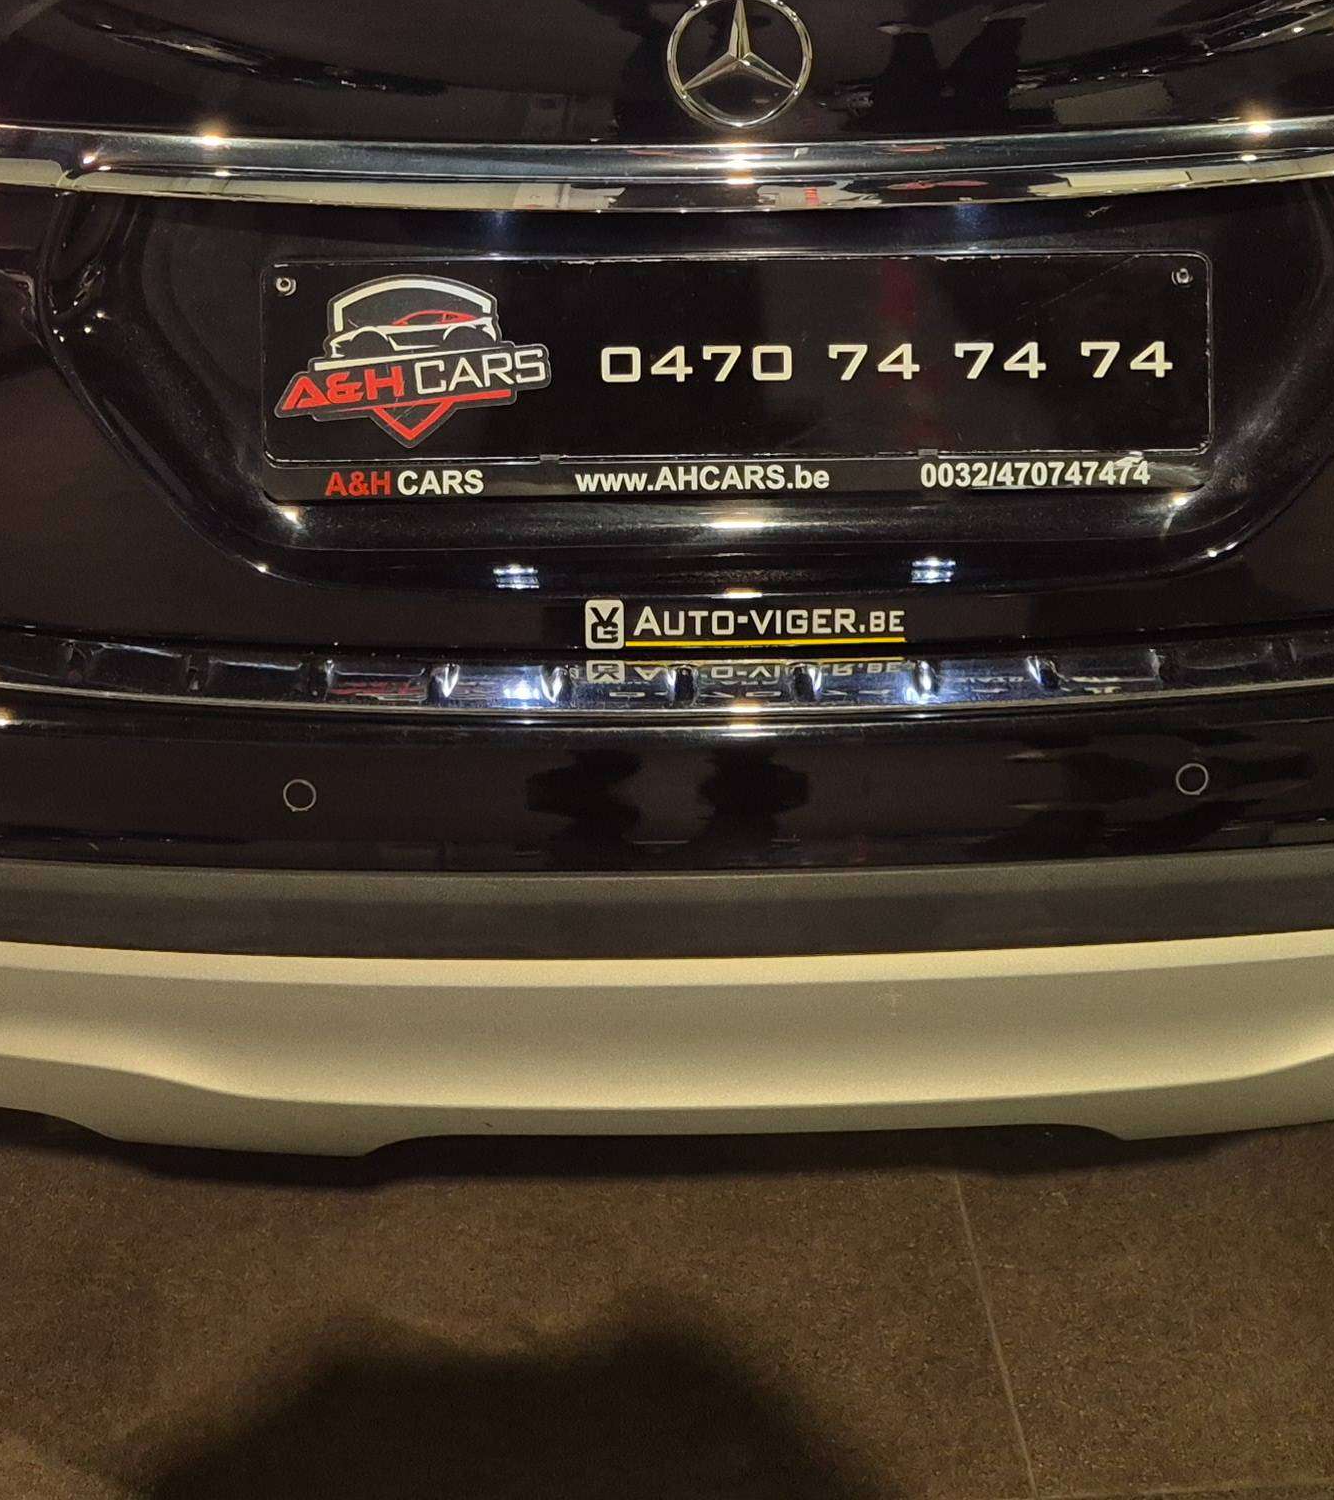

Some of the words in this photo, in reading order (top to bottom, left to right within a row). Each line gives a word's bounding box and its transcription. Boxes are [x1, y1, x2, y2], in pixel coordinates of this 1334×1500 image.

[282, 365, 405, 411] A&H
[414, 349, 547, 395] CARS
[601, 345, 793, 383] 0470
[828, 343, 920, 381] 74
[954, 341, 1047, 380] 74
[1080, 341, 1173, 378] 74
[325, 470, 391, 496] A&H
[397, 469, 484, 495] CARS
[574, 464, 830, 492] www.AHCARS.be
[920, 460, 1151, 488] 0032/470747474
[633, 606, 905, 637] AUTO-VIGER.BE
